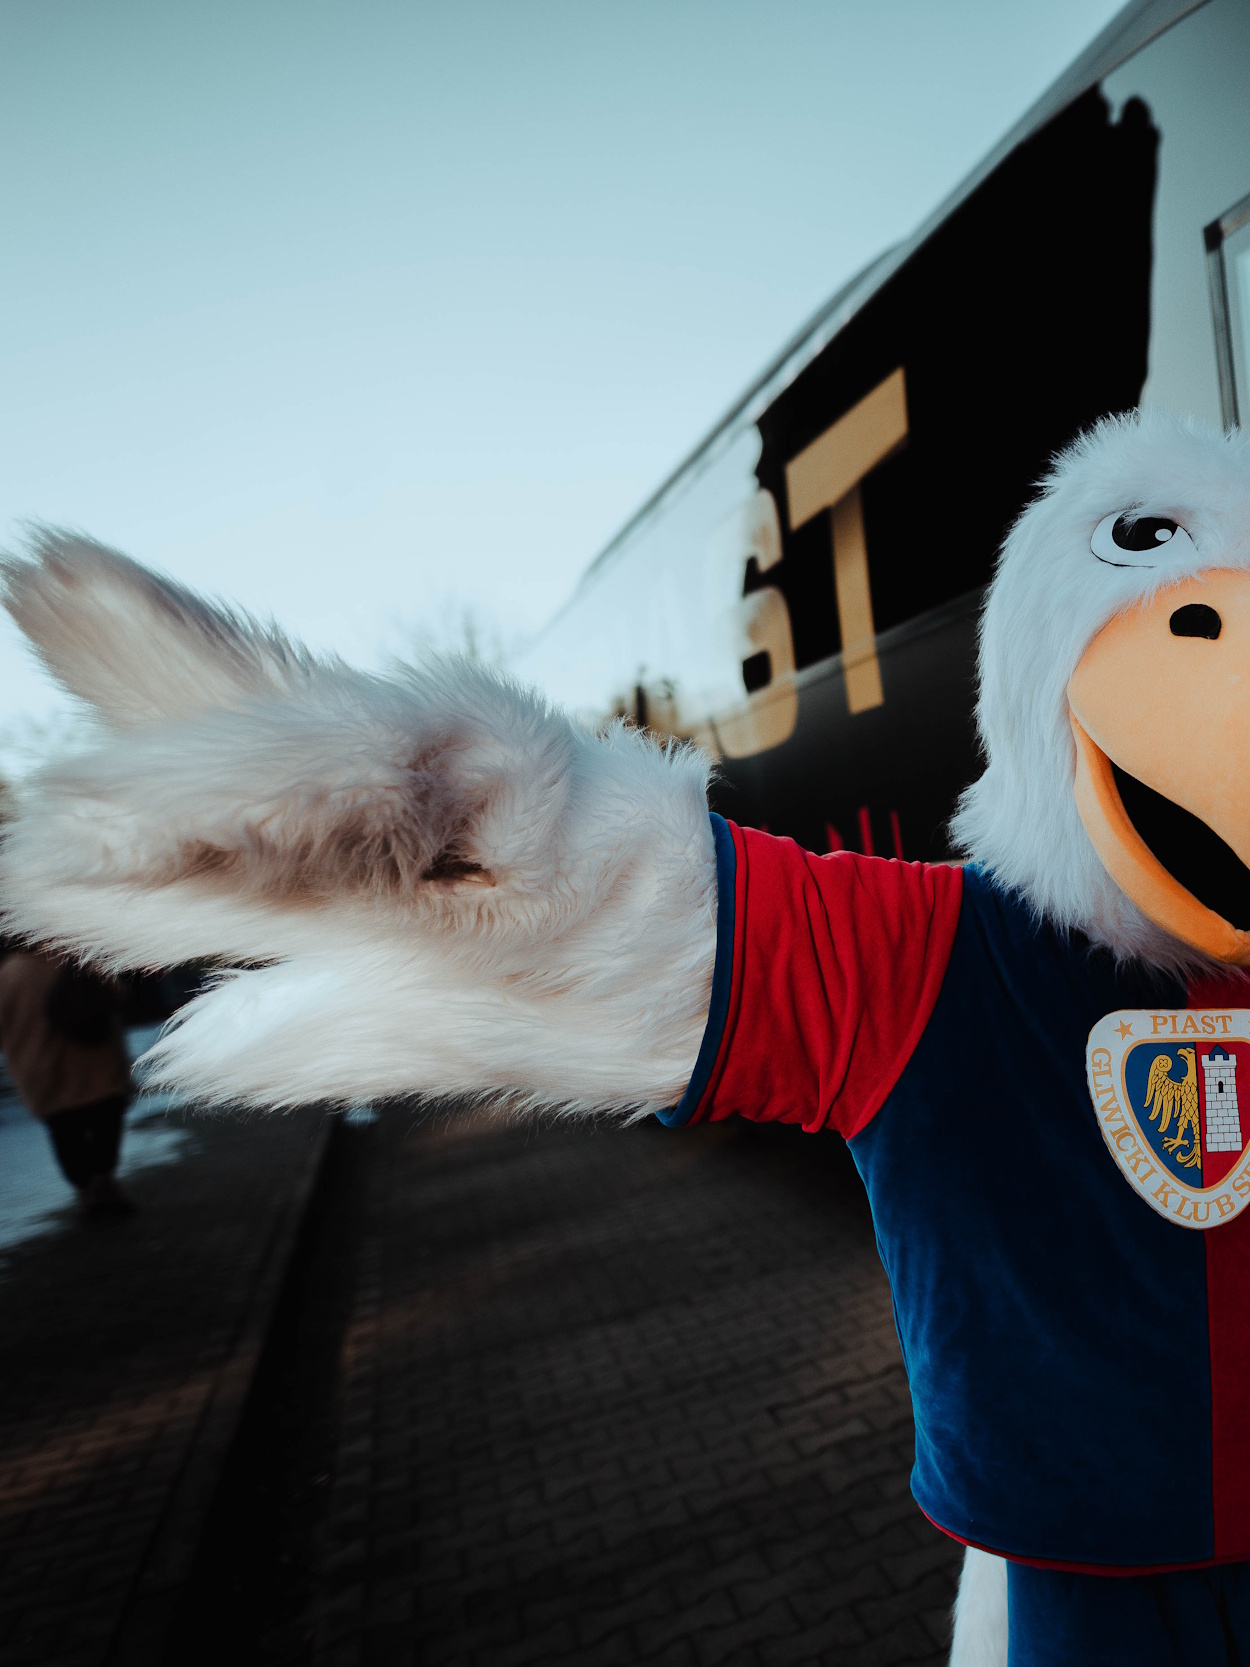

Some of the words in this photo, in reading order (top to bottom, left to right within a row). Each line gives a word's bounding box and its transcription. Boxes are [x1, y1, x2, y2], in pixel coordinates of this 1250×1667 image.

[1149, 1014, 1233, 1035] PIAST
[1090, 1046, 1159, 1186] GLIWICKI
[1150, 1178, 1236, 1223] KLUB
